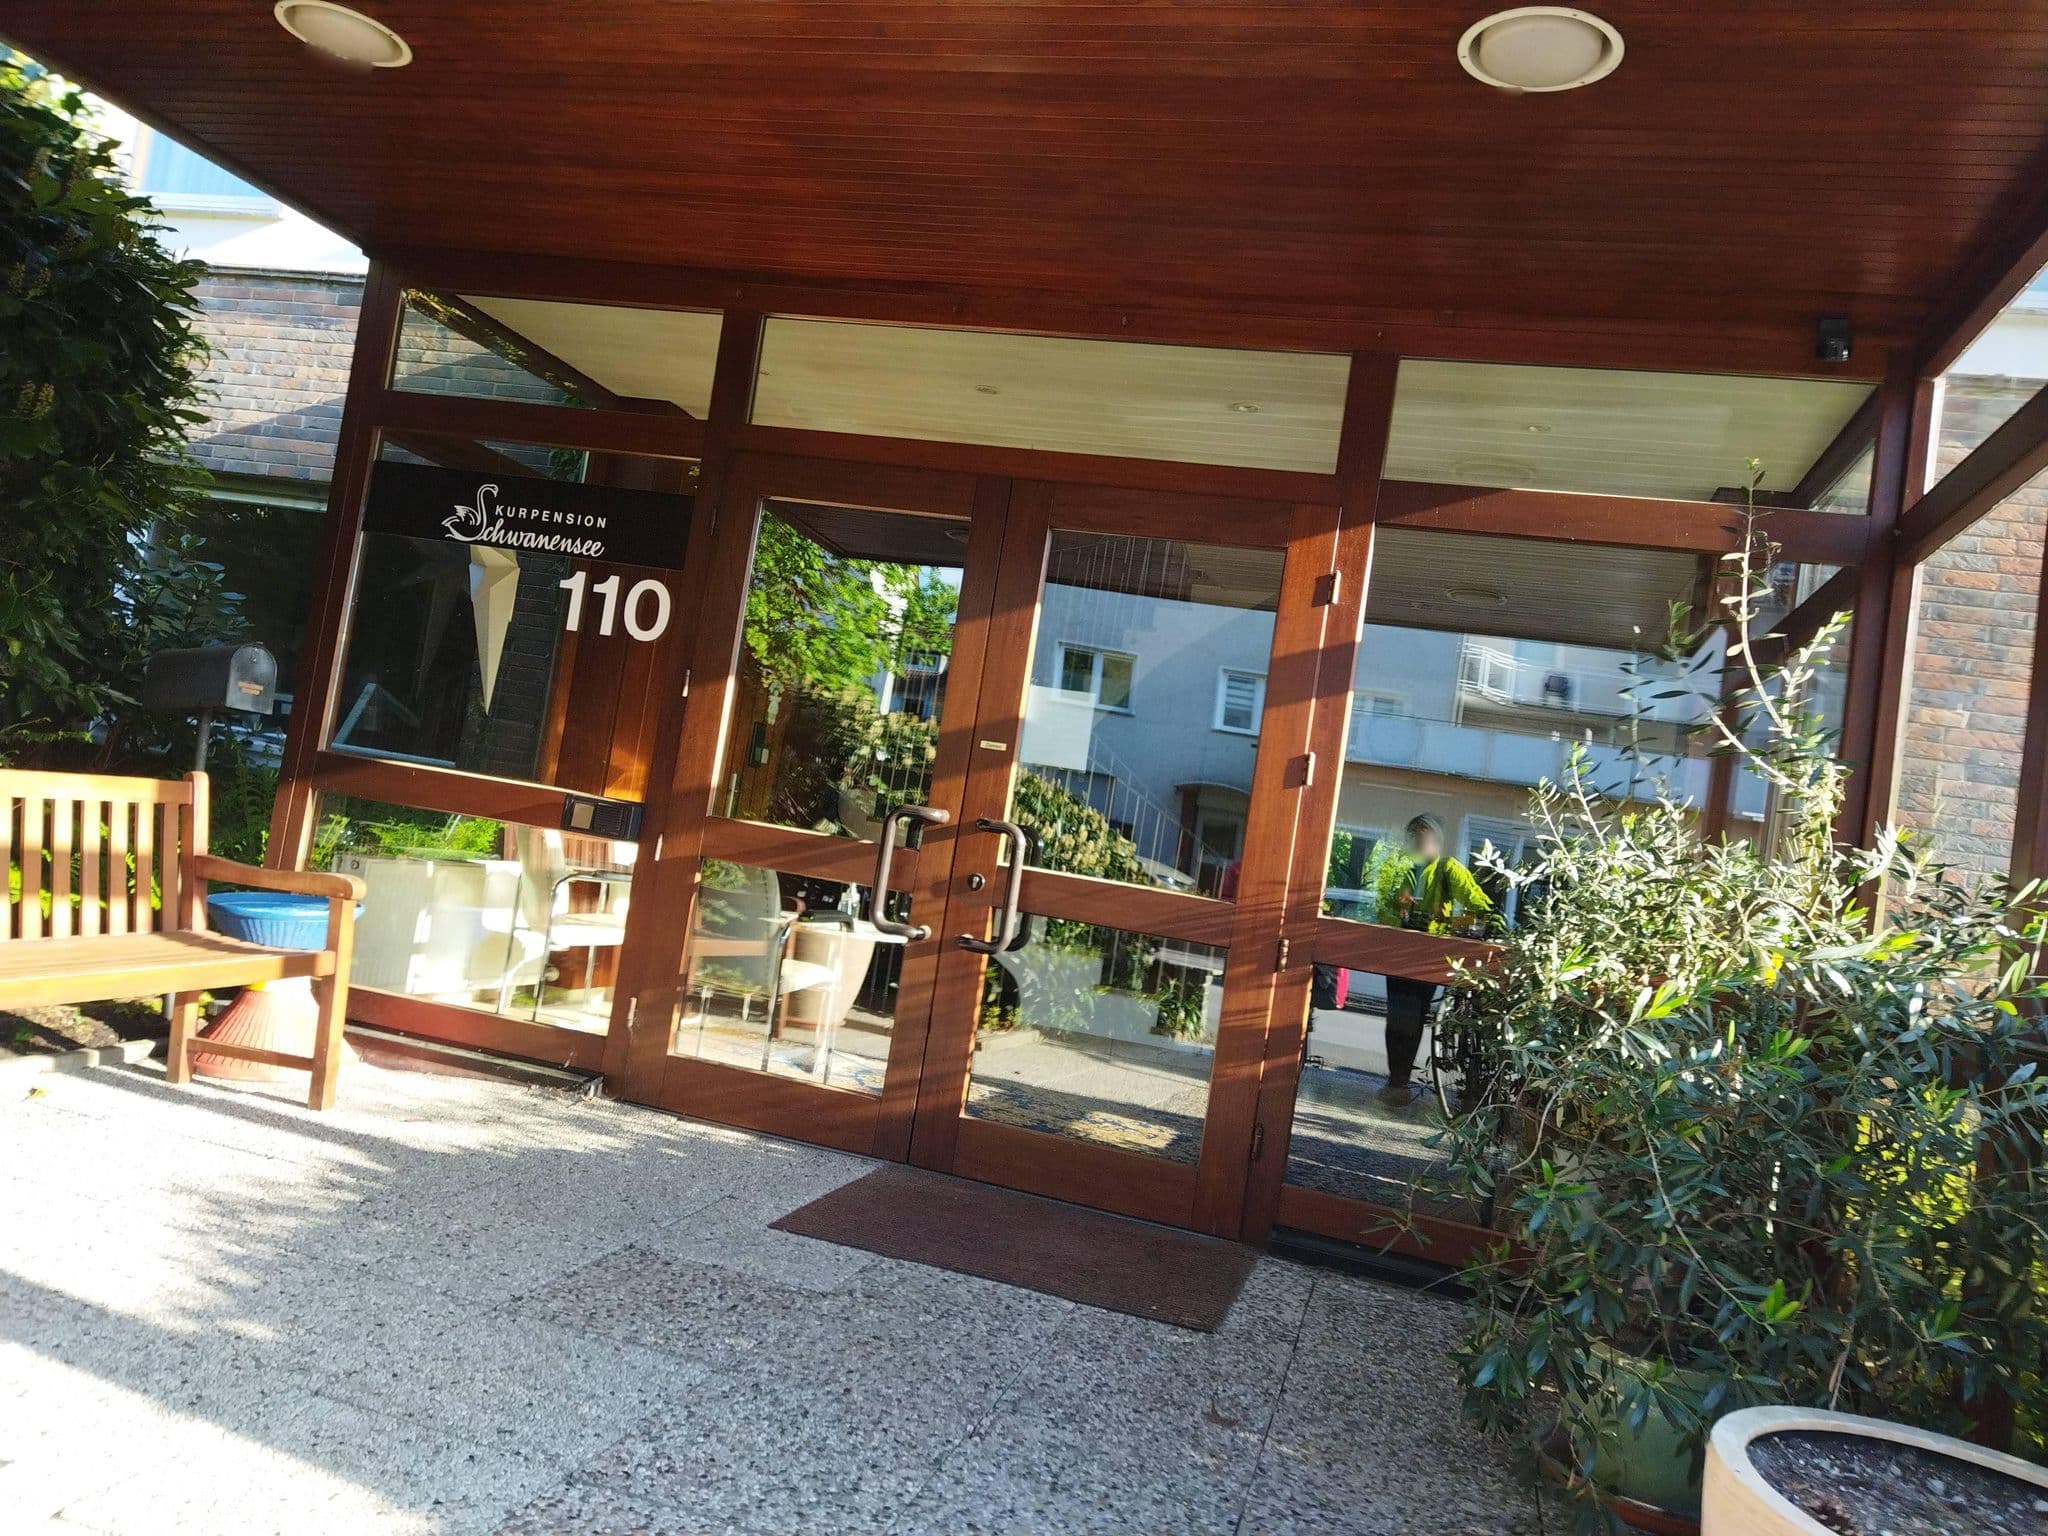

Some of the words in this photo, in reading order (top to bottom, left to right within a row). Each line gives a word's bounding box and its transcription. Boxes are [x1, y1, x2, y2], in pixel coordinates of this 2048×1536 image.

[441, 484, 605, 557] Schwanensee
[495, 504, 607, 529] KURPENSION
[559, 570, 671, 642] 110
